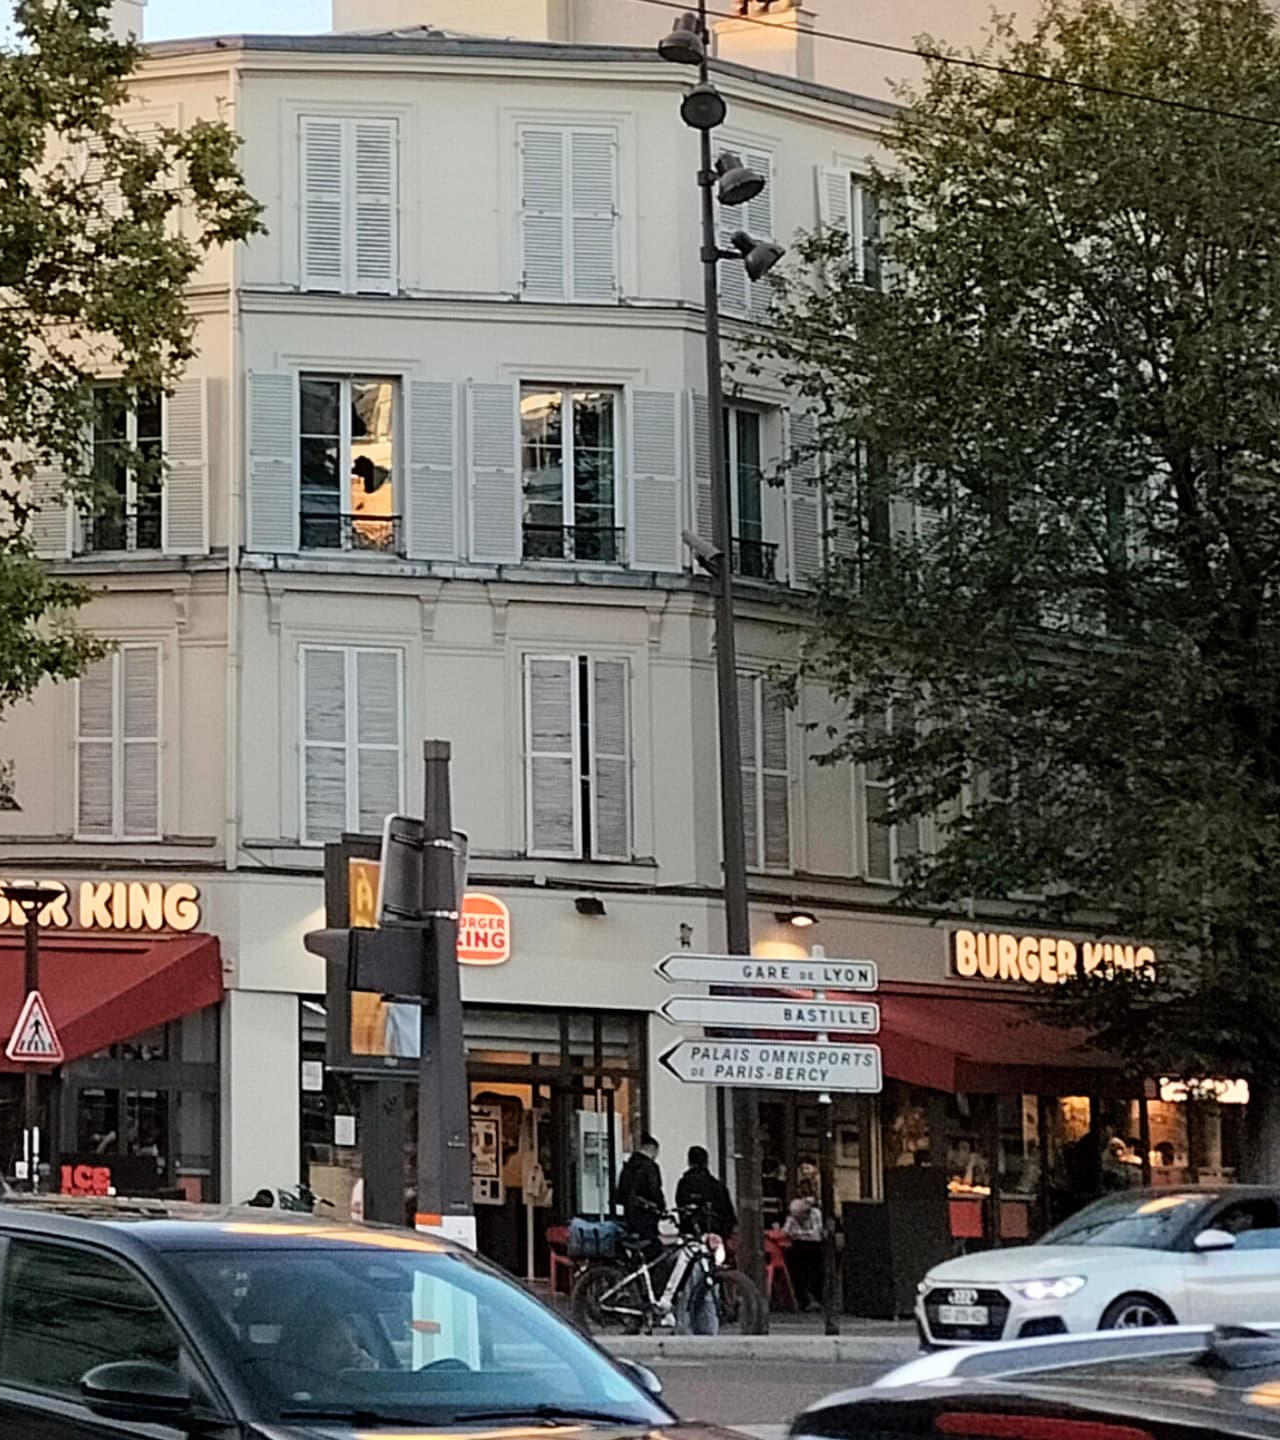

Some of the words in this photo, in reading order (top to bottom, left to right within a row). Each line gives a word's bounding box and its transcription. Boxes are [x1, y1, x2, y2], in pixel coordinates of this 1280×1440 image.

[79, 881, 201, 931] KING
[460, 918, 505, 929] URGER
[955, 929, 1078, 985] BURGER
[742, 965, 790, 979] GARE
[799, 970, 814, 981] DE
[823, 968, 868, 982] LYON
[783, 1008, 870, 1025] BASTILLE
[691, 1046, 750, 1061] PALAIS
[759, 1050, 873, 1067] OMNISPORTS
[691, 1067, 705, 1078] DE
[713, 1064, 829, 1082] PARIS-BERCY
[61, 1165, 111, 1189] ICE
